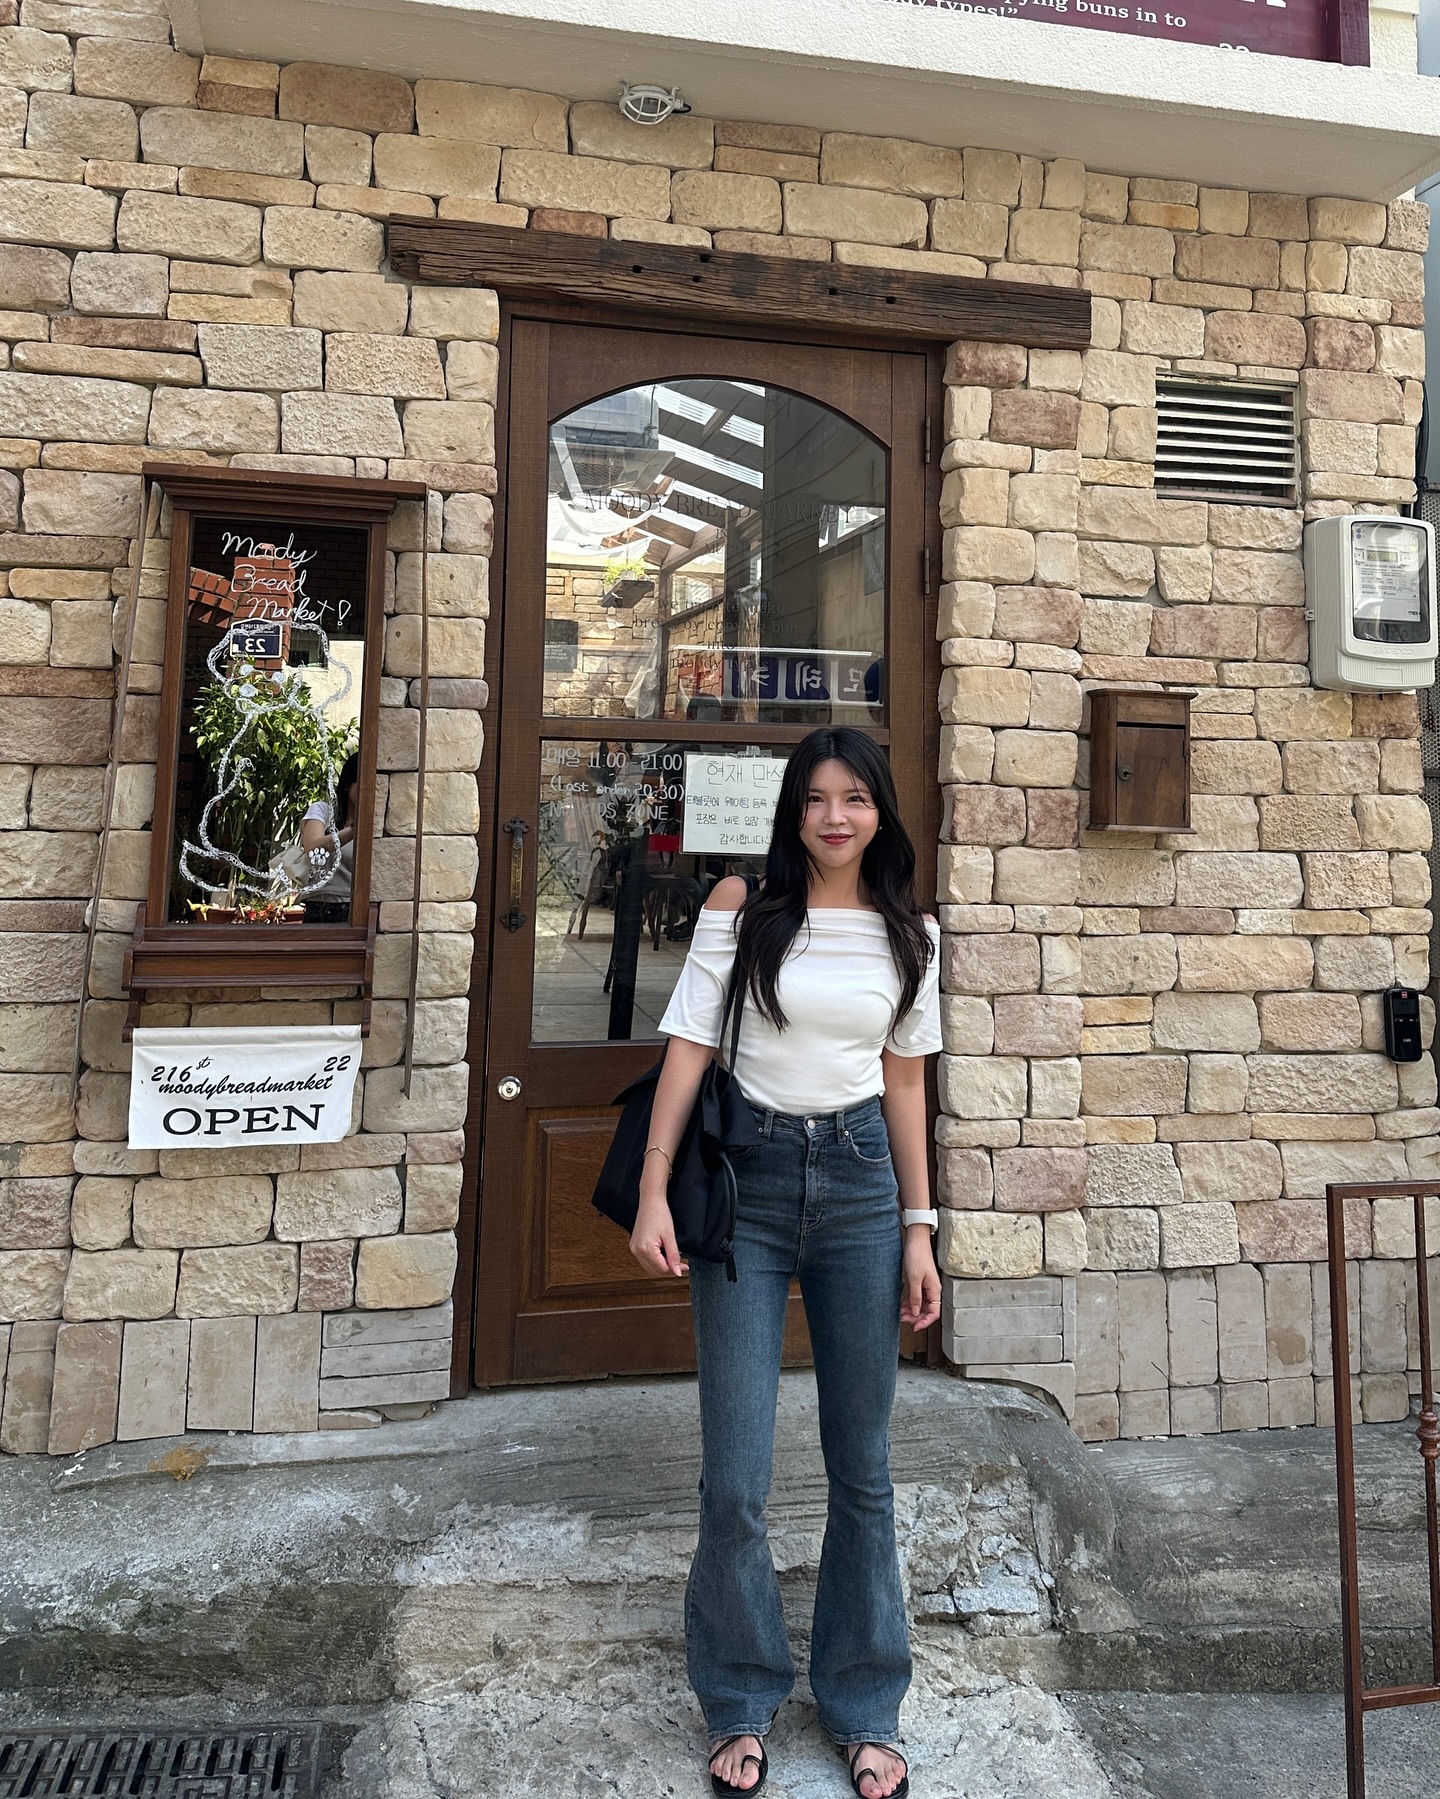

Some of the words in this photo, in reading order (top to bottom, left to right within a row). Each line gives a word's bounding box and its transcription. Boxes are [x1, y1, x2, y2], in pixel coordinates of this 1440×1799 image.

[1075, 0, 1129, 19] buns
[1136, 7, 1158, 23] in
[1164, 13, 1187, 28] to
[584, 490, 667, 513] MOODY
[675, 494, 753, 519] BREAD
[231, 563, 308, 597] Bread
[771, 619, 807, 634] buns
[706, 760, 744, 786] 현재
[695, 813, 719, 825] 포장은
[323, 1054, 351, 1072] 22
[158, 1073, 334, 1100] moodybreadmarket
[162, 1103, 326, 1136] OPEN
